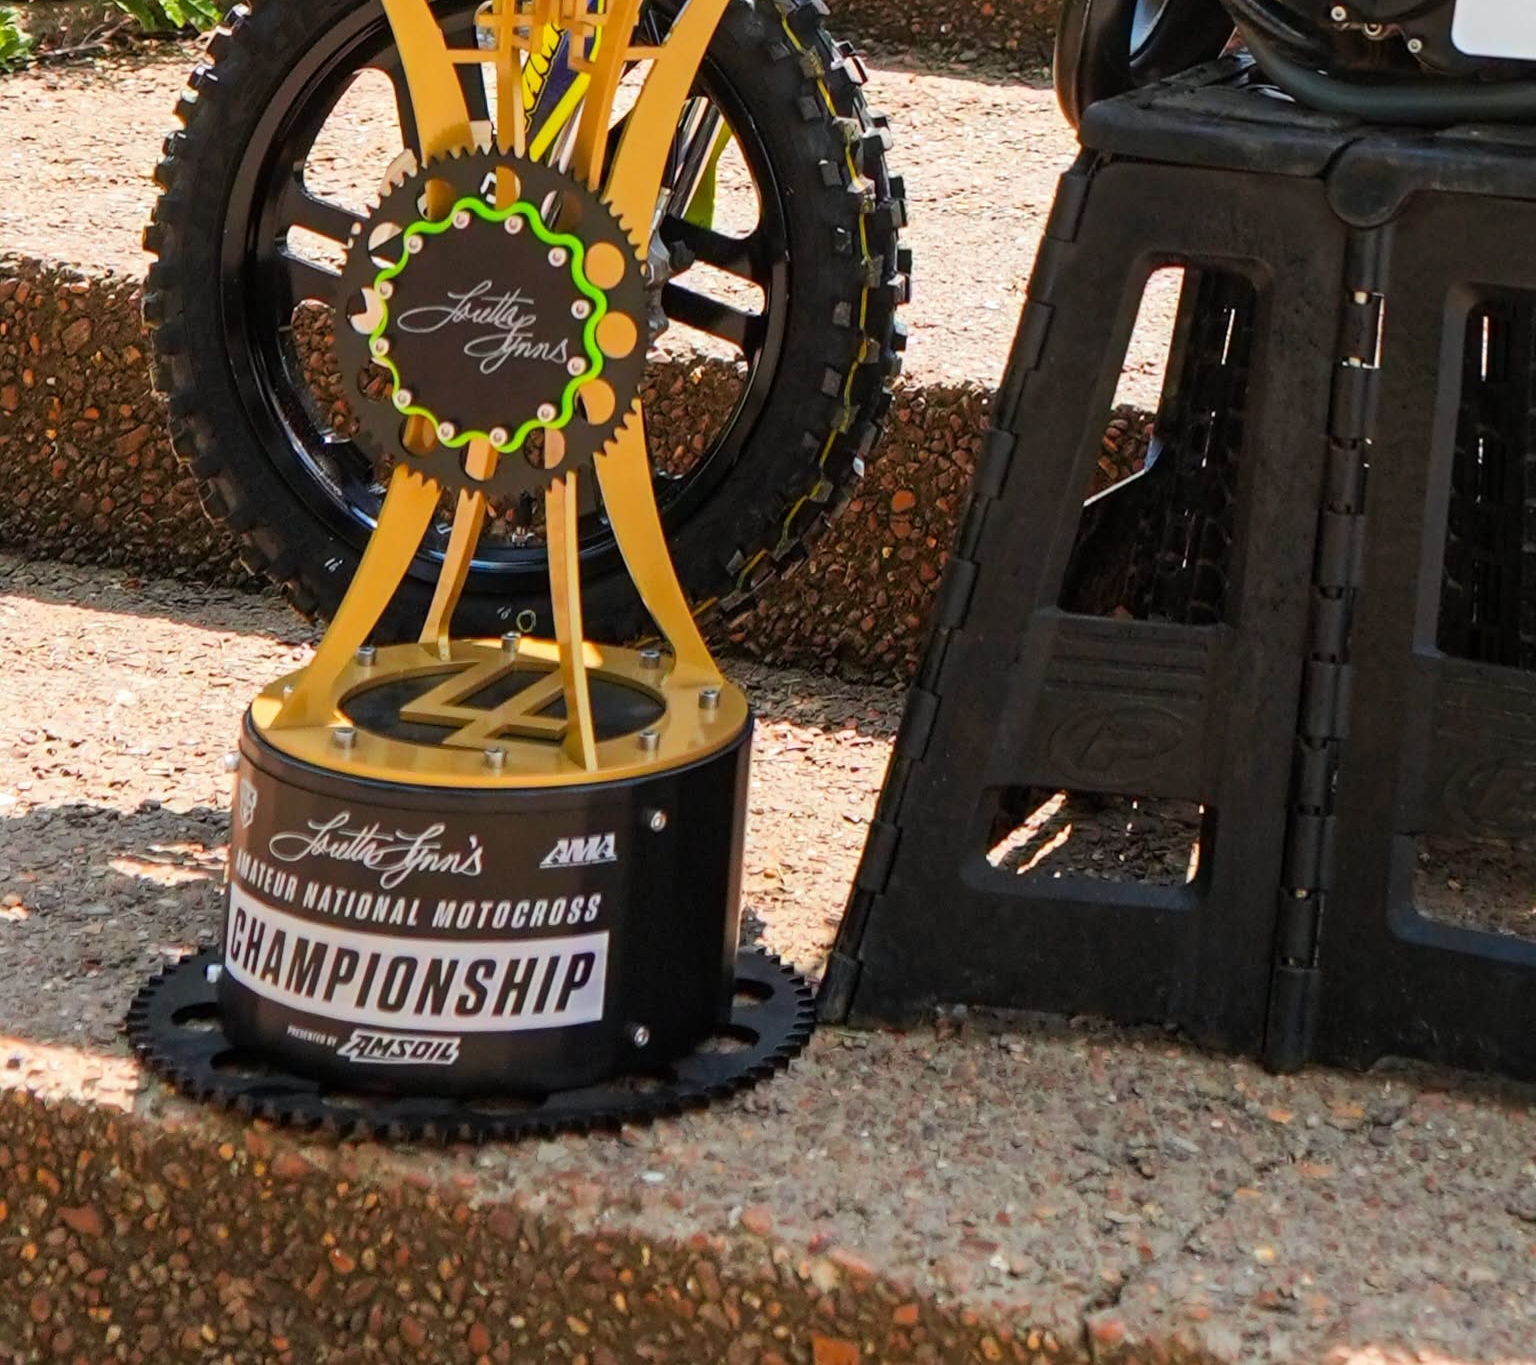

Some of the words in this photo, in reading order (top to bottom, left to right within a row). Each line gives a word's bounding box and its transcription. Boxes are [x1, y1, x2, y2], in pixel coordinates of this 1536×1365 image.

[539, 831, 618, 868] AMA
[235, 848, 299, 903] AMATEUR
[302, 880, 421, 927] NATIONAL
[431, 893, 602, 931] MOTOCROSS
[229, 906, 597, 1021] CHAMPIONSHIP
[337, 1029, 462, 1065] AMSOIL
